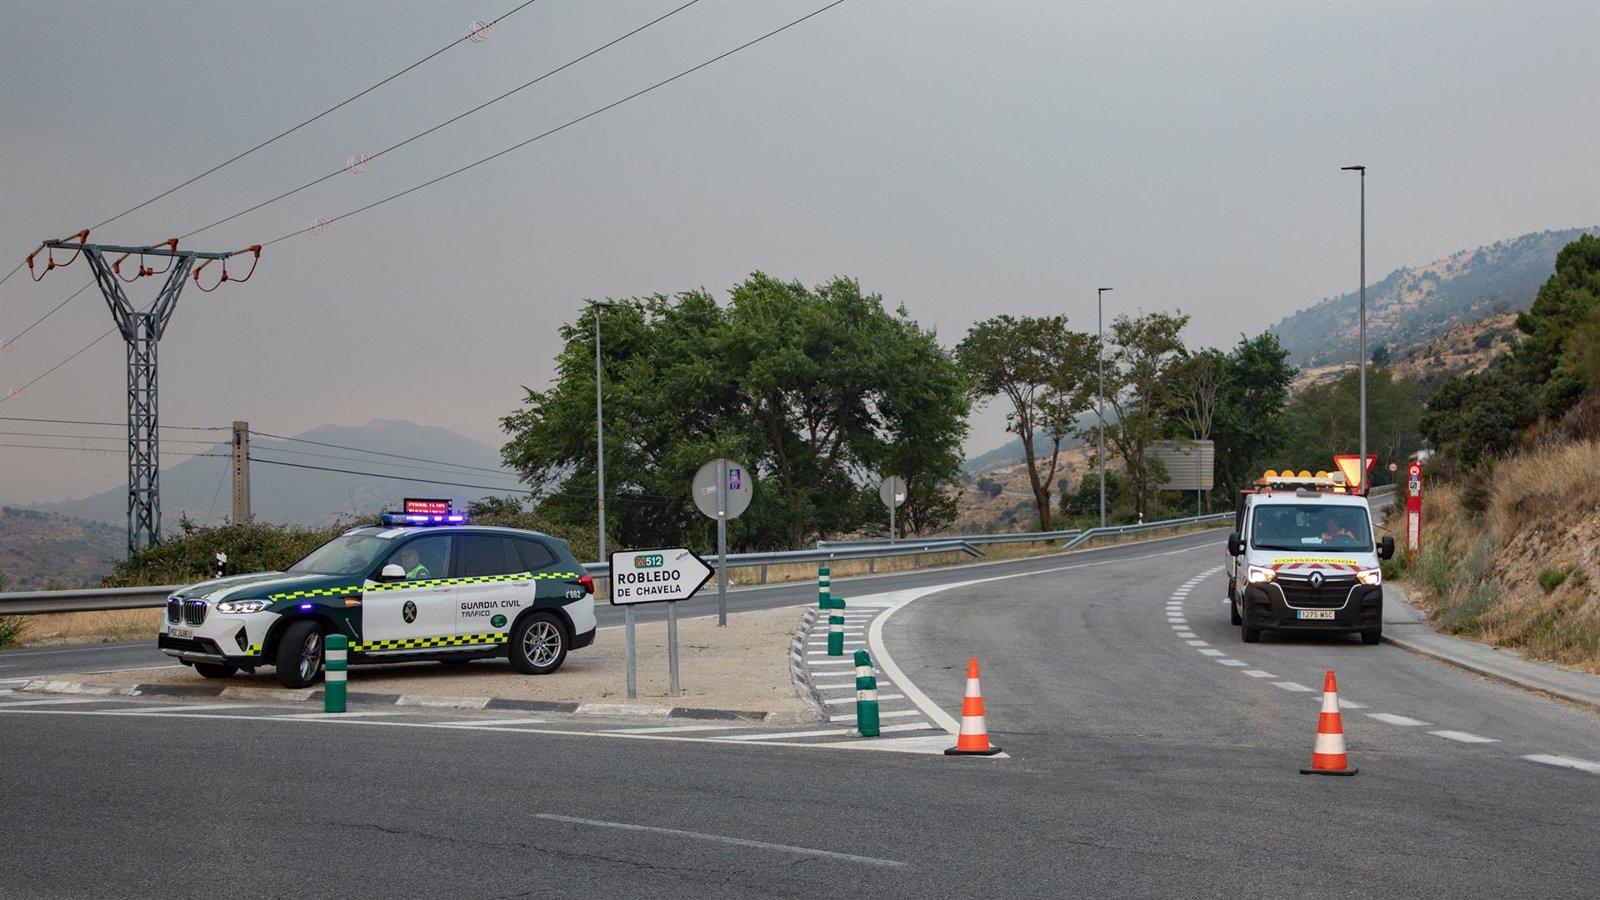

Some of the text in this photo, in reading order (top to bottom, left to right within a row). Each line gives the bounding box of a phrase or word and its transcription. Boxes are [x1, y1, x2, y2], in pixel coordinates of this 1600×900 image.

[646, 556, 662, 566] 512
[618, 570, 680, 584] ROBLEDO
[617, 584, 681, 597] DE CHAVELA
[461, 601, 498, 610] GUARDIA
[1301, 610, 1319, 619] 1275
